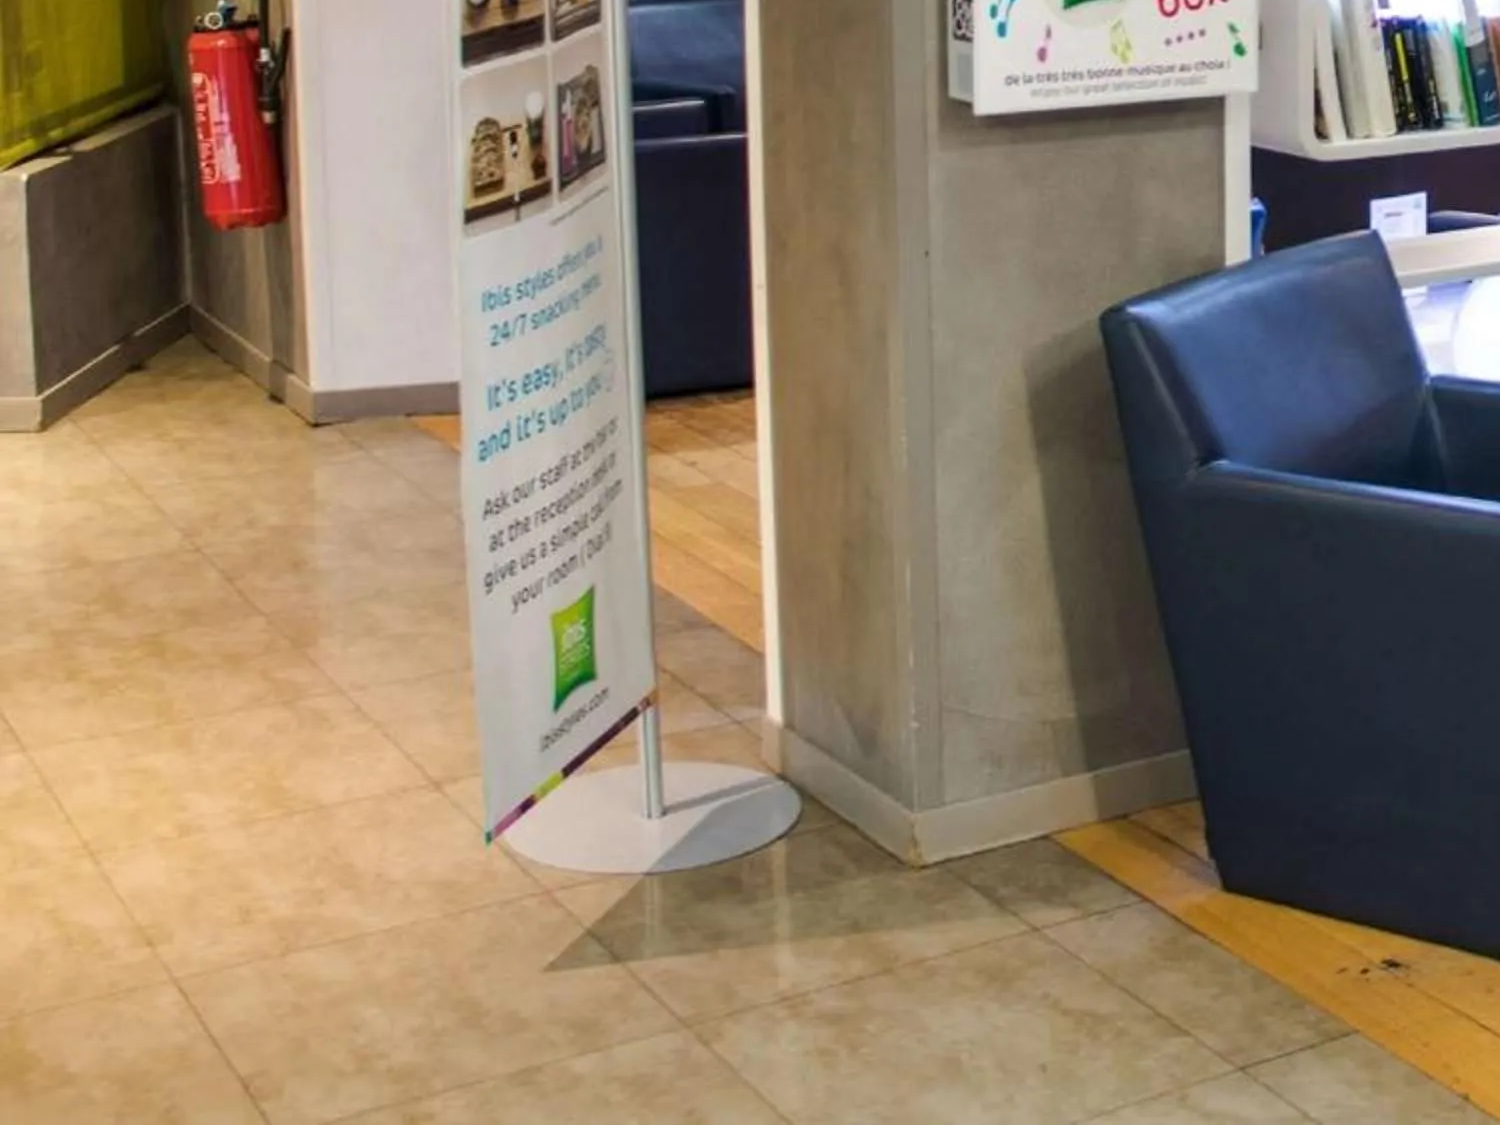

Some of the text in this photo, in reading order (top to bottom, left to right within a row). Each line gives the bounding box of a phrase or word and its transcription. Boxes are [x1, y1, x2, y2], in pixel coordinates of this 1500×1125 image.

[488, 313, 528, 347] 24/7
[477, 419, 512, 462] and
[516, 410, 546, 442] it's
[482, 489, 511, 521] Ask
[512, 477, 536, 504] our
[507, 515, 532, 543] the
[484, 557, 517, 597] give
[520, 547, 537, 571] us
[511, 575, 545, 615] your
